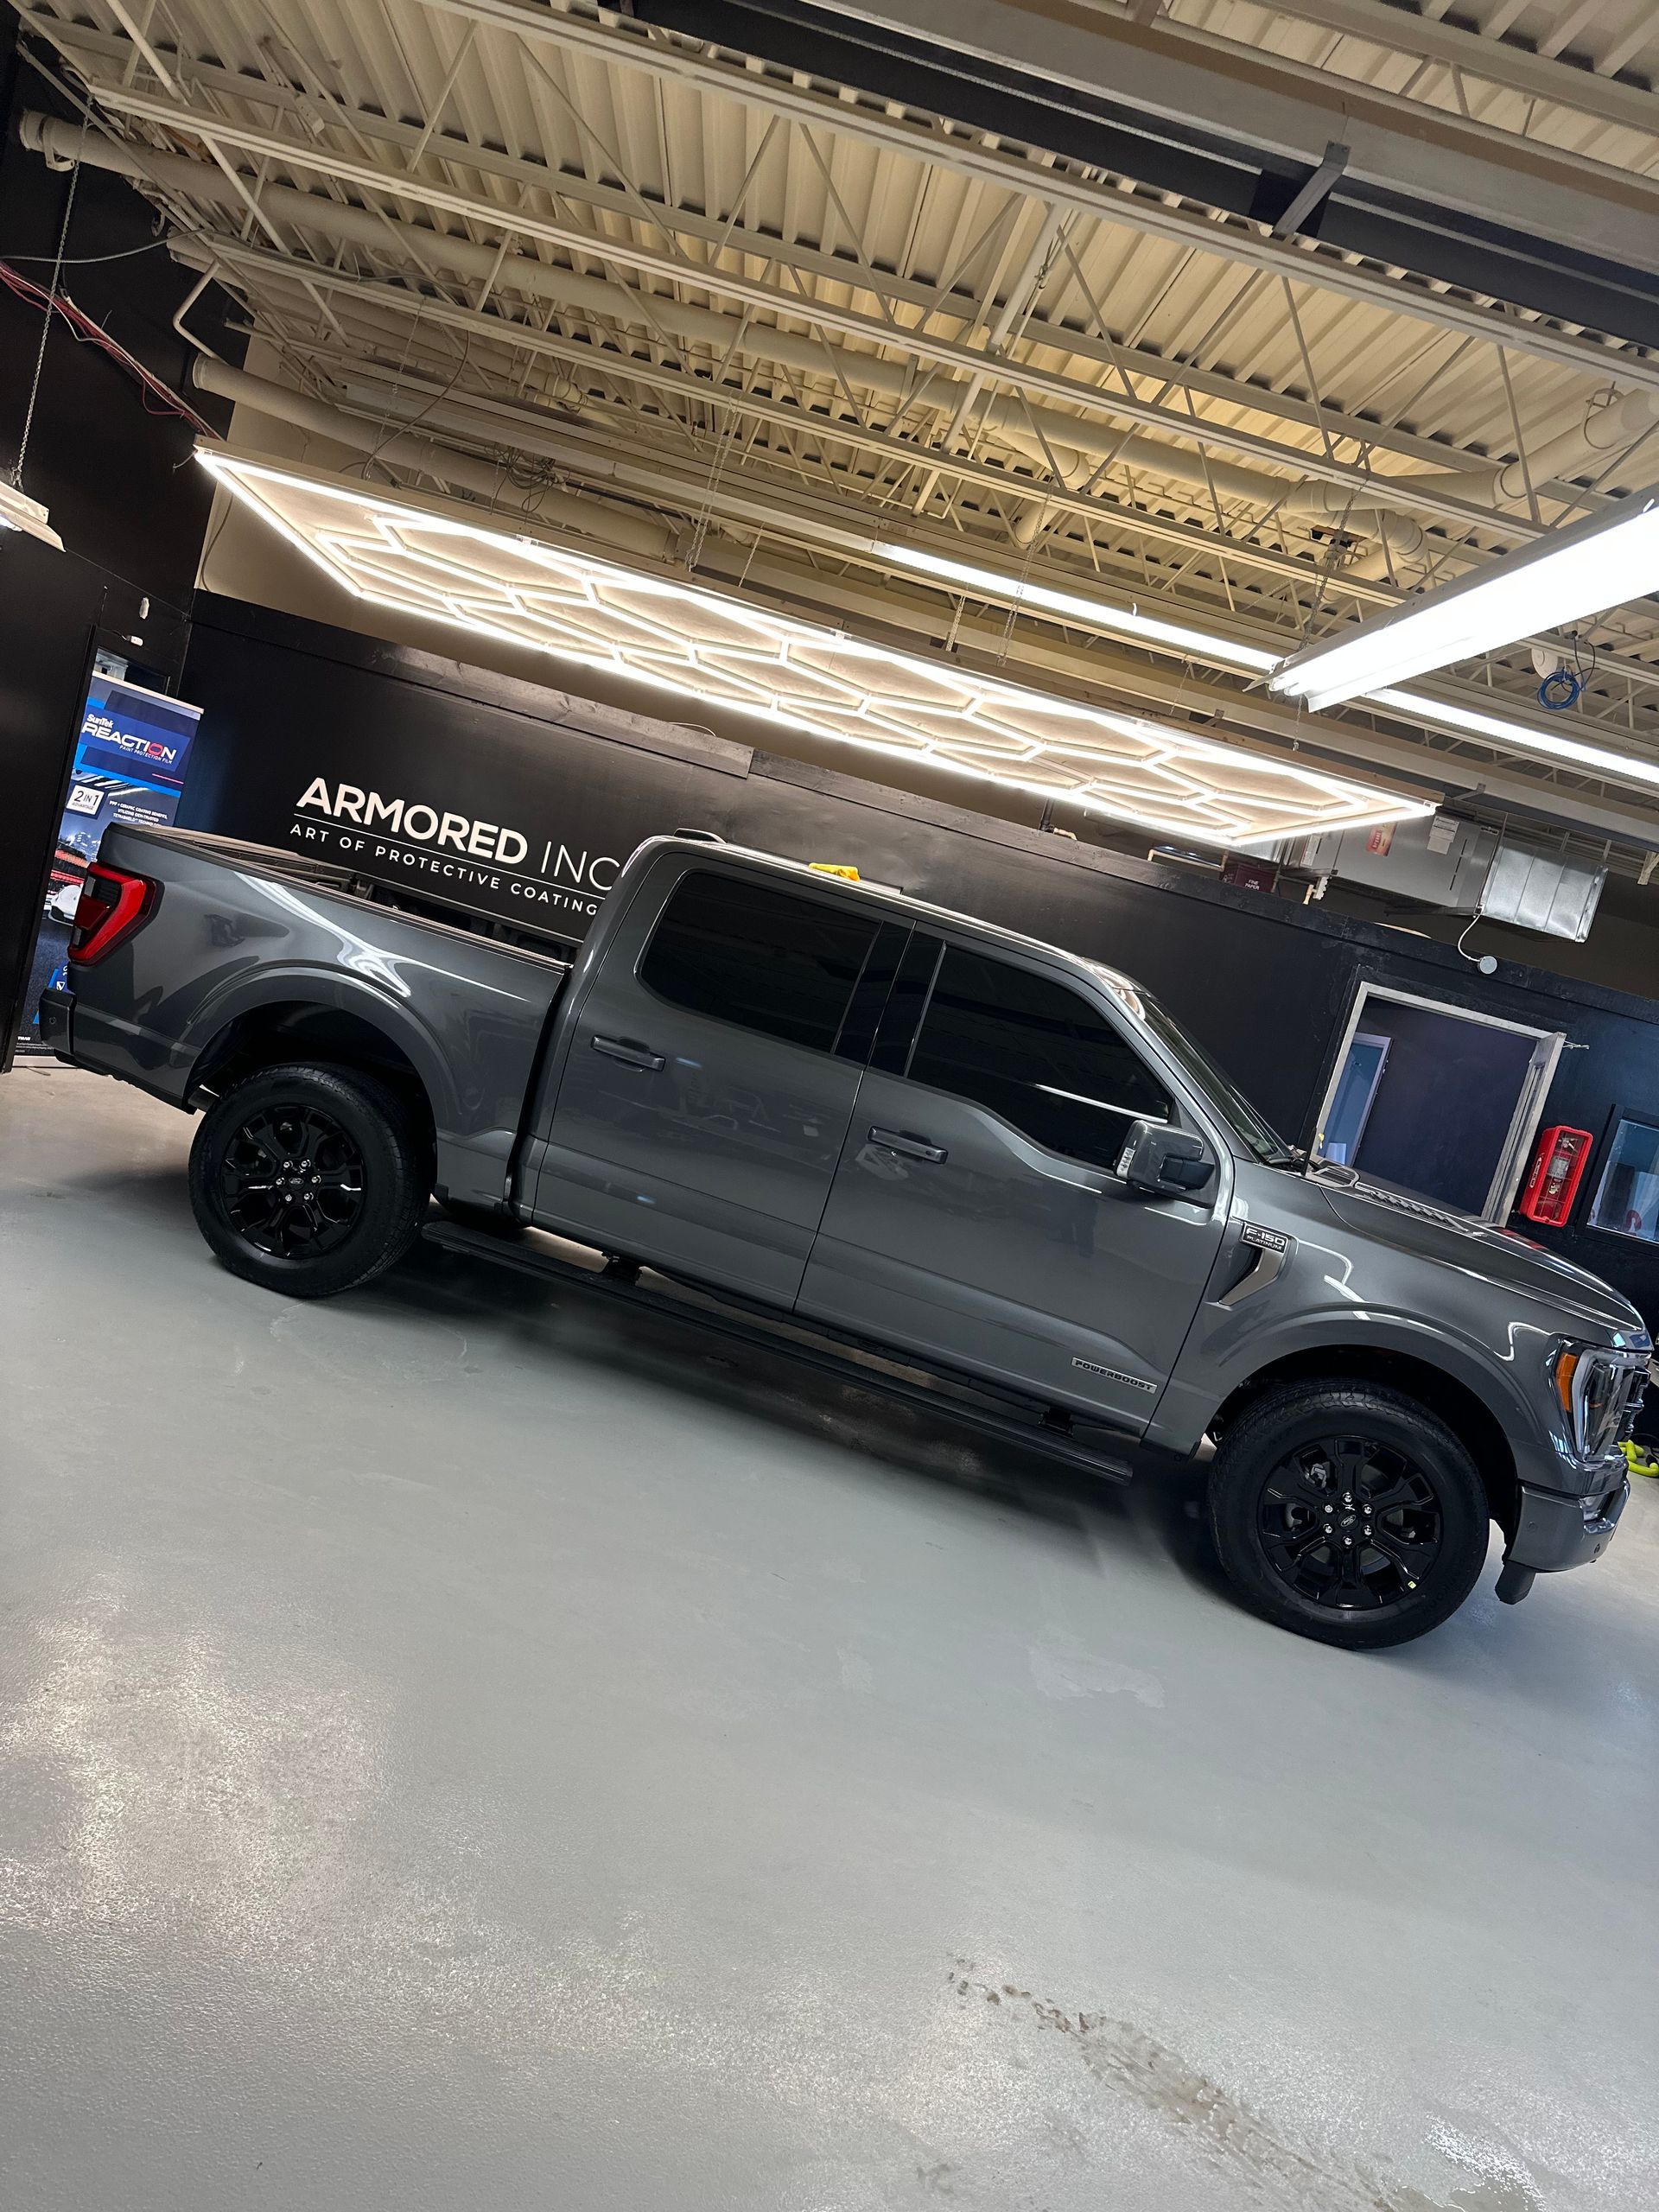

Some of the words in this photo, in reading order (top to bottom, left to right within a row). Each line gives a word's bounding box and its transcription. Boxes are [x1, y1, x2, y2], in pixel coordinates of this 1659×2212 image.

[86, 714, 114, 728] SunTek
[81, 721, 177, 760] REACTION
[134, 749, 162, 761] PROTECTION
[73, 790, 85, 803] 2
[83, 794, 92, 803] IN
[92, 794, 100, 806] 1
[296, 777, 528, 865] ARMORED
[540, 841, 621, 891] INC
[289, 823, 329, 843] ART
[339, 836, 366, 852] OF
[374, 845, 500, 890] PROTECTIVE
[511, 882, 599, 916] COATING
[1246, 1227, 1286, 1246] F-150
[1246, 1235, 1282, 1250] PLATINUM
[1075, 1359, 1154, 1390] POWERBOOST
